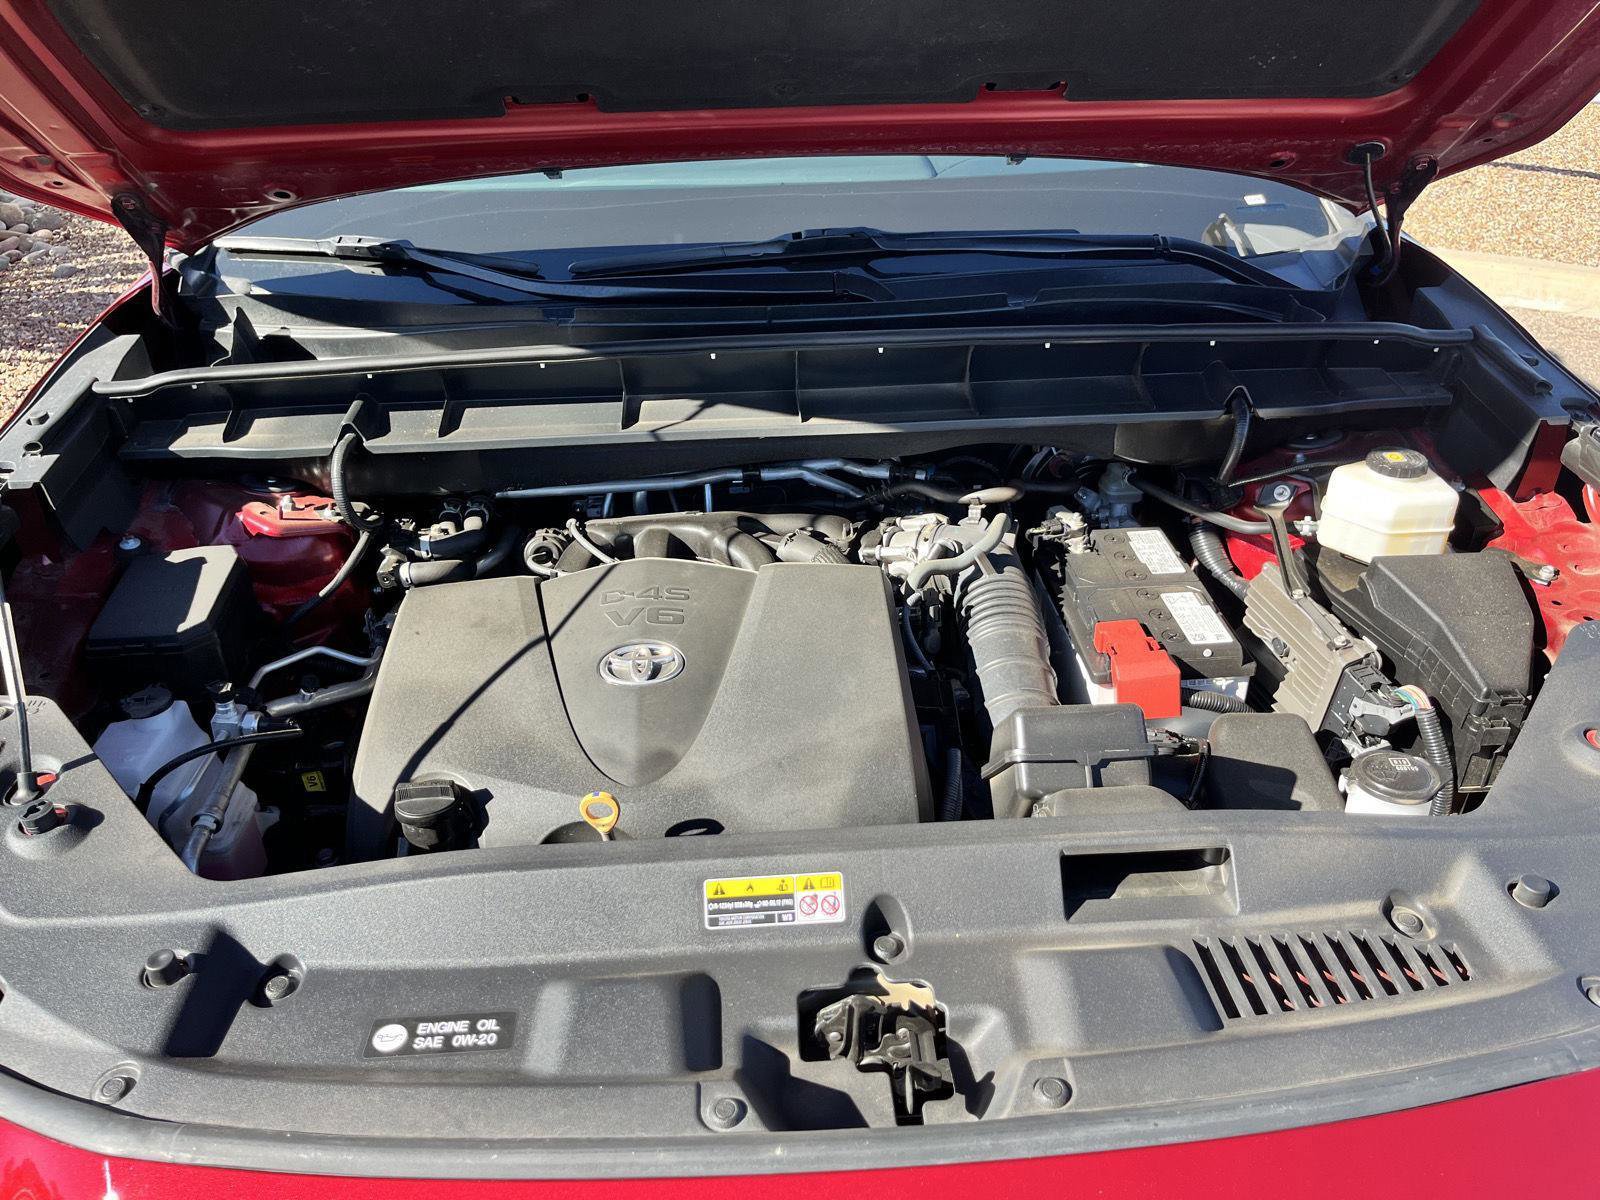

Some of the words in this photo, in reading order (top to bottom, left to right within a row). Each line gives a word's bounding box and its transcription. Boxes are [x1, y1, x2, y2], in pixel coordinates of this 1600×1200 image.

[600, 585, 690, 606] D-4S
[604, 606, 685, 627] V6
[416, 1020, 470, 1034] ENGINE
[476, 1018, 500, 1031] OIL
[412, 1035, 444, 1049] SAE
[451, 1032, 498, 1047] 0W-20
